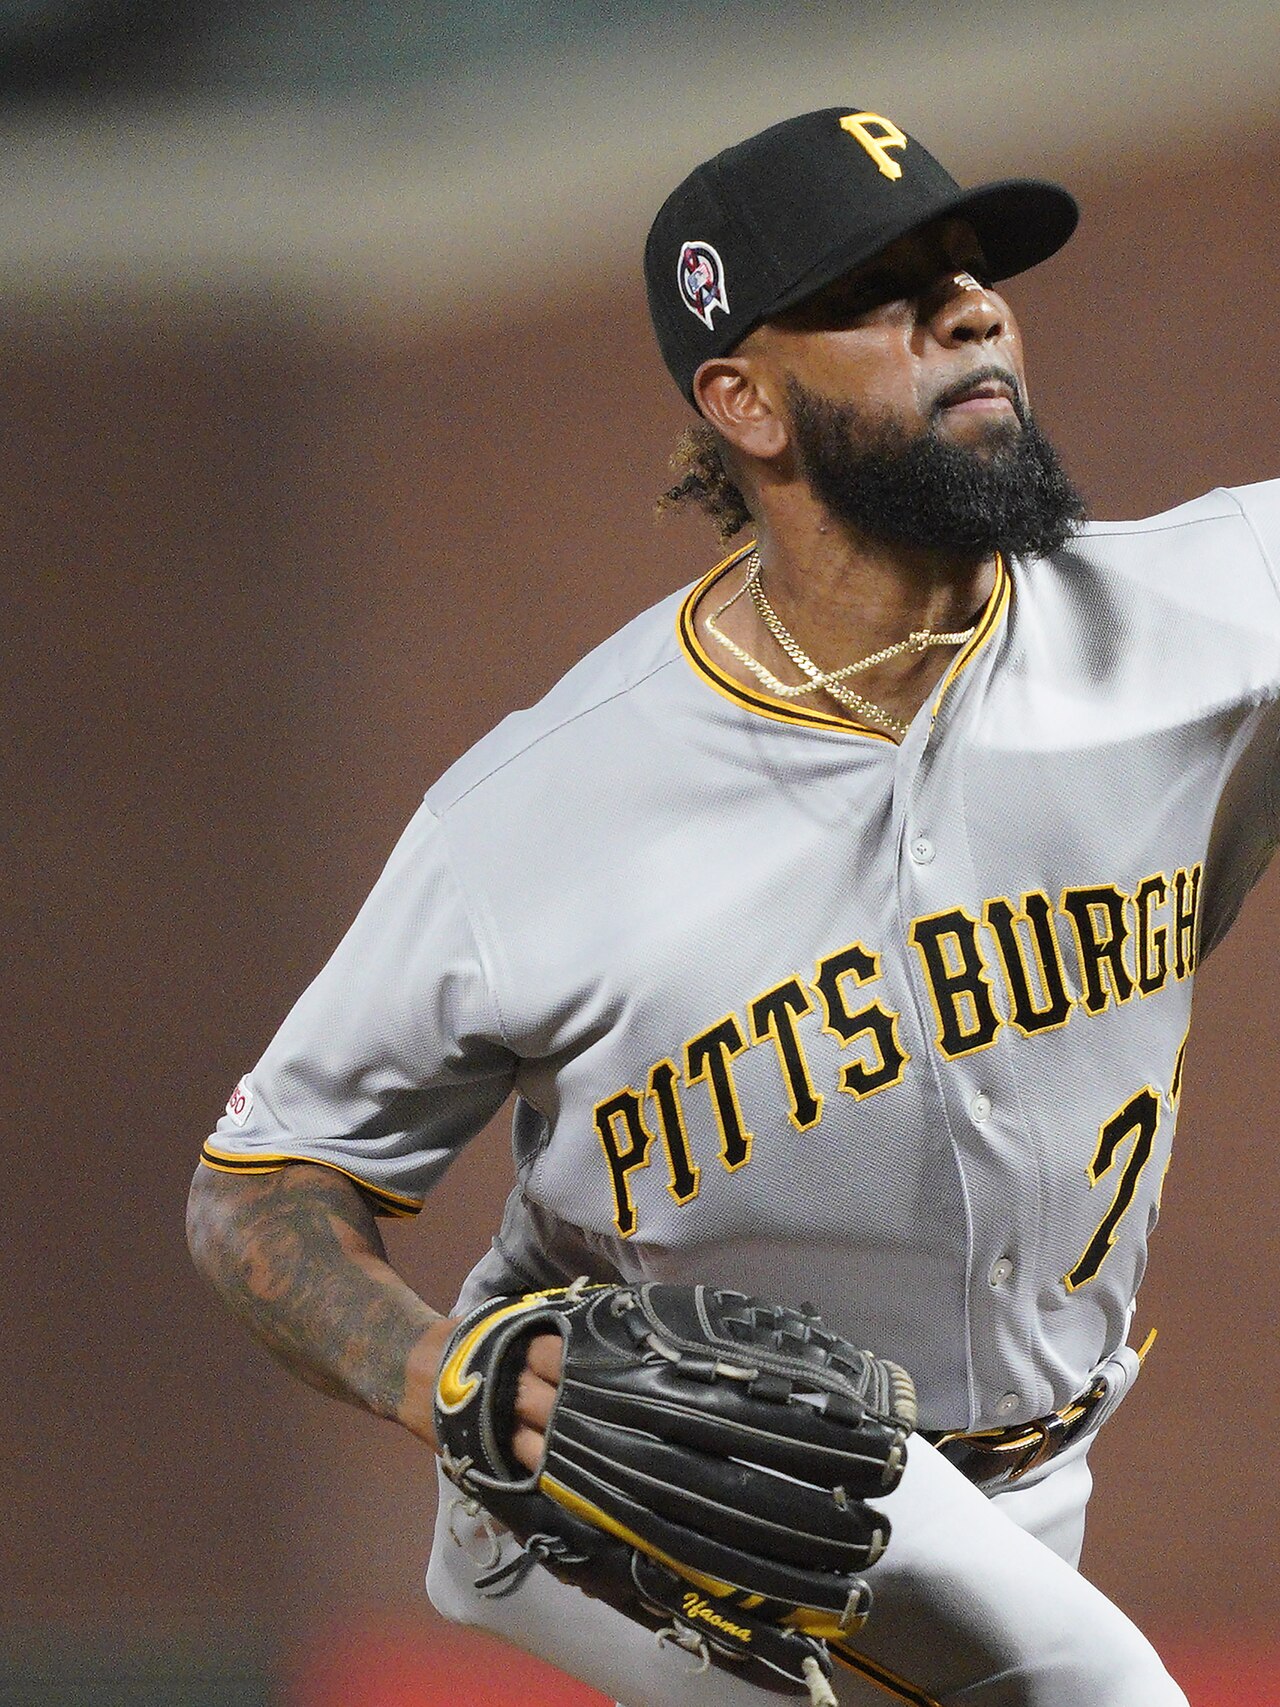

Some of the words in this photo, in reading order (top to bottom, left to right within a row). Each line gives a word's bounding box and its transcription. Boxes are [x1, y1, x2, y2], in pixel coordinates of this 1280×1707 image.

[838, 111, 908, 181] P
[592, 861, 1203, 1239] PITTSBURGH
[1064, 1022, 1191, 1292] 7
